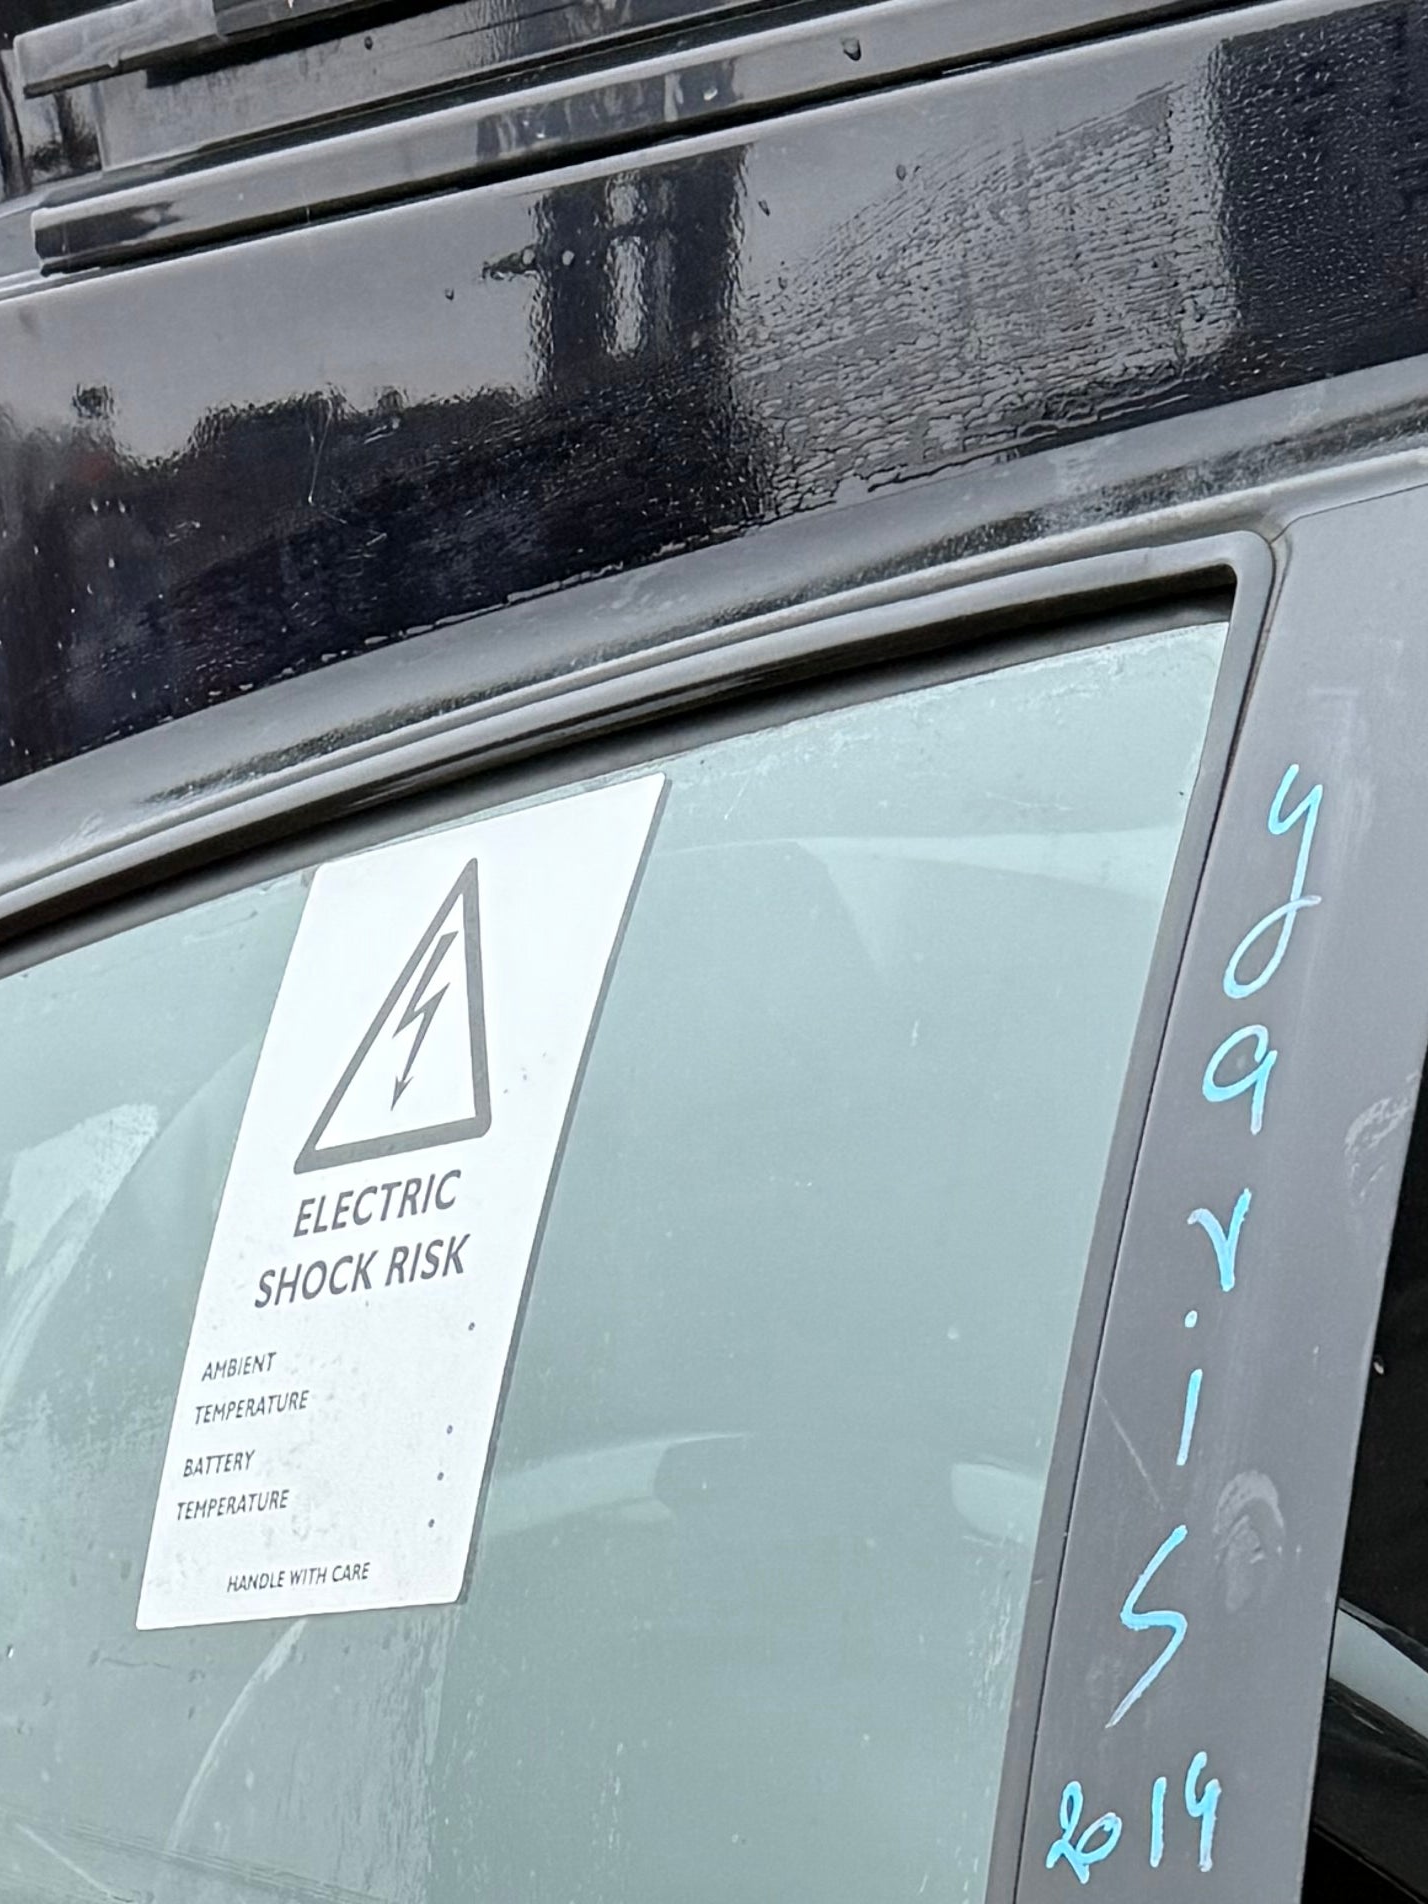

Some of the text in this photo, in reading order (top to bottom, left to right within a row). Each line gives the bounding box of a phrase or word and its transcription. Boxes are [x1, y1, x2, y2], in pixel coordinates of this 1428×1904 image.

[292, 1168, 462, 1238] ELECTRIC
[254, 1233, 471, 1309] SHOCK RISK
[200, 1351, 277, 1382] AMBIENT
[194, 1389, 310, 1426] TEMPERATURE
[182, 1449, 256, 1478] BATTERY
[176, 1488, 290, 1521] TEMPERATURE
[226, 1561, 371, 1593] HANDLE WITH CARE
